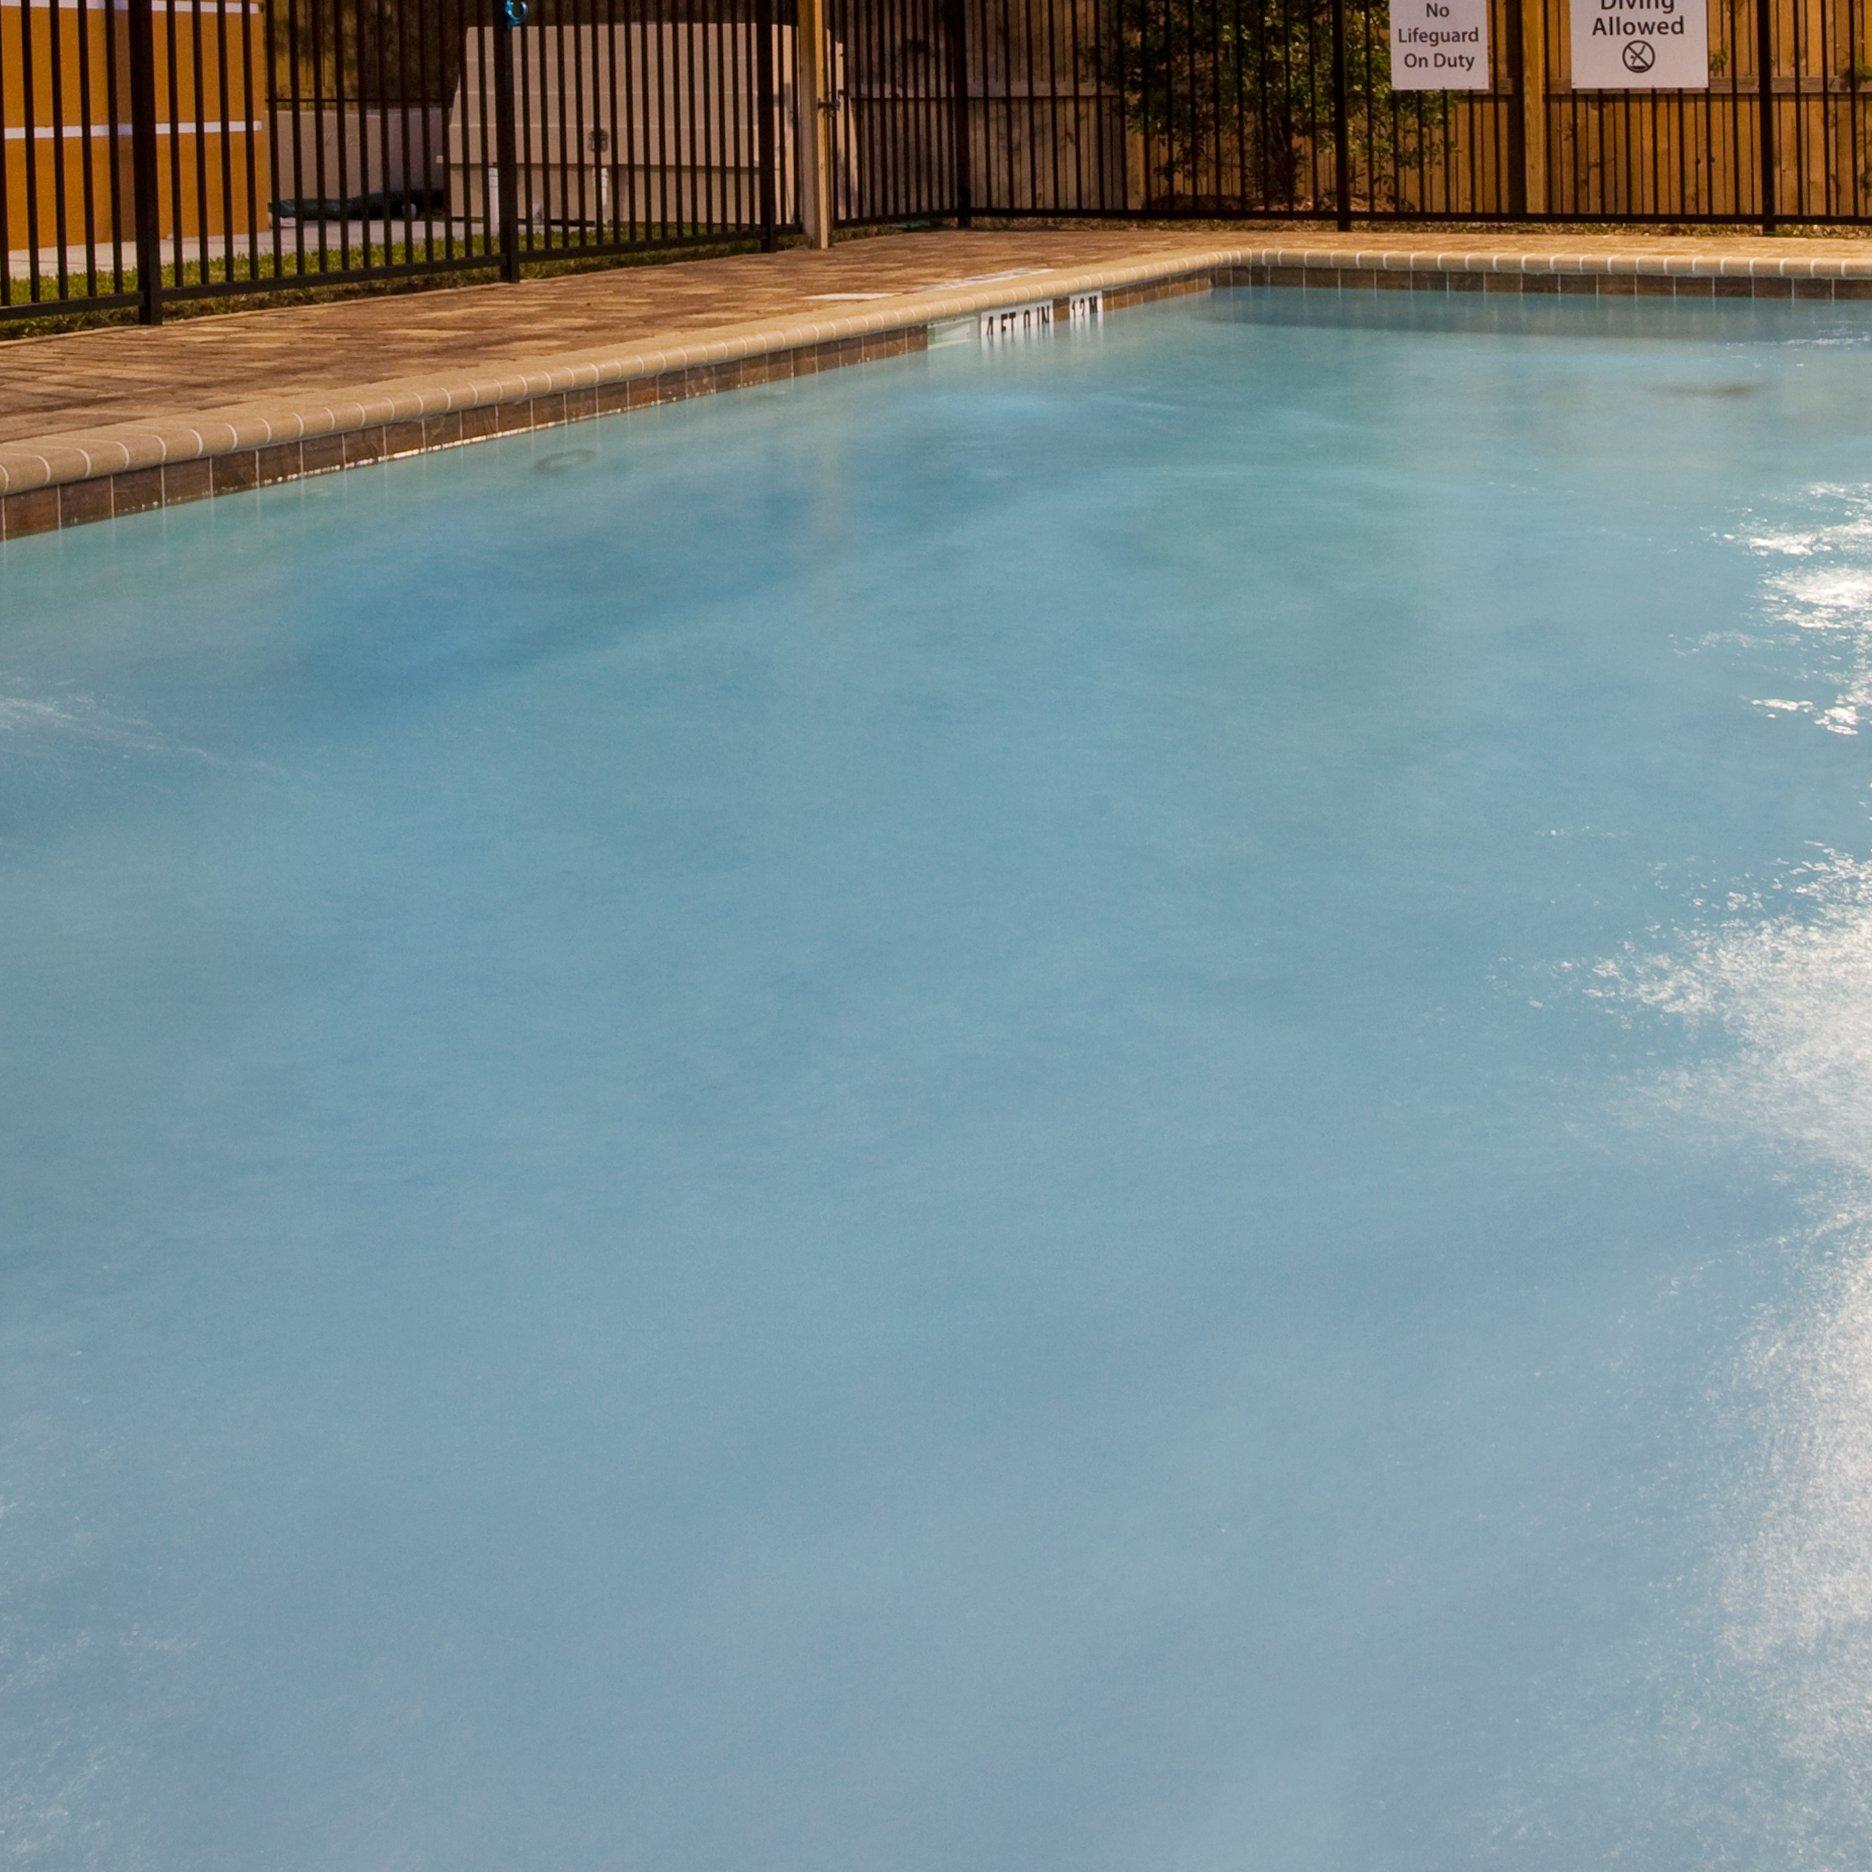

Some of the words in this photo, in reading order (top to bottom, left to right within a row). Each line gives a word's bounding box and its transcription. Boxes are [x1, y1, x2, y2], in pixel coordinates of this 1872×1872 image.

[1426, 2, 1450, 18] No
[1592, 15, 1684, 36] Allowed
[1398, 26, 1479, 47] Lifeguard
[1404, 52, 1428, 68] On
[1434, 52, 1475, 72] Duty
